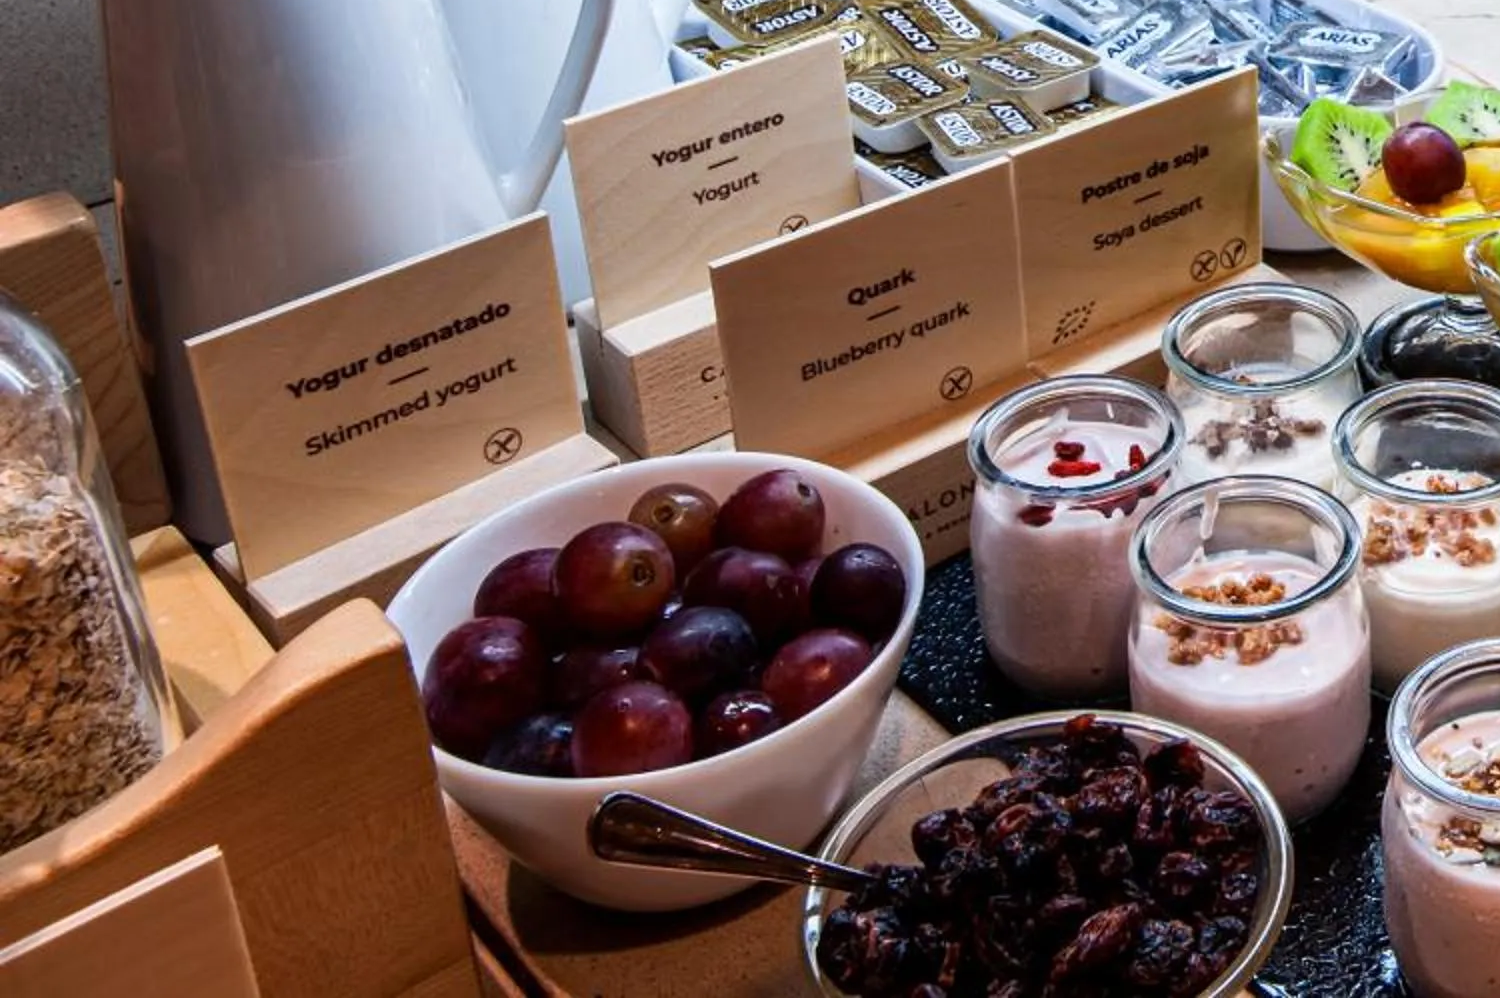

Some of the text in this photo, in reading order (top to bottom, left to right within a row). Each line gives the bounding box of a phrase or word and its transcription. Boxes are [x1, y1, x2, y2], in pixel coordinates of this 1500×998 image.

[756, 5, 818, 33] ASTOR
[882, 9, 938, 51] ASTOR
[1108, 19, 1159, 59] ARIAS
[1313, 31, 1370, 47] ARIAS
[892, 67, 945, 97] ASTOR
[652, 112, 785, 168] Yogur entero
[692, 171, 760, 206] Yogurt
[1081, 144, 1210, 204] Postre de soja
[1092, 194, 1204, 252] Soya dessert
[847, 267, 916, 306] Quark
[285, 302, 512, 399] Yogur desnatado
[801, 301, 971, 382] Blueberry quark
[304, 357, 518, 457] Skimmed yogurt
